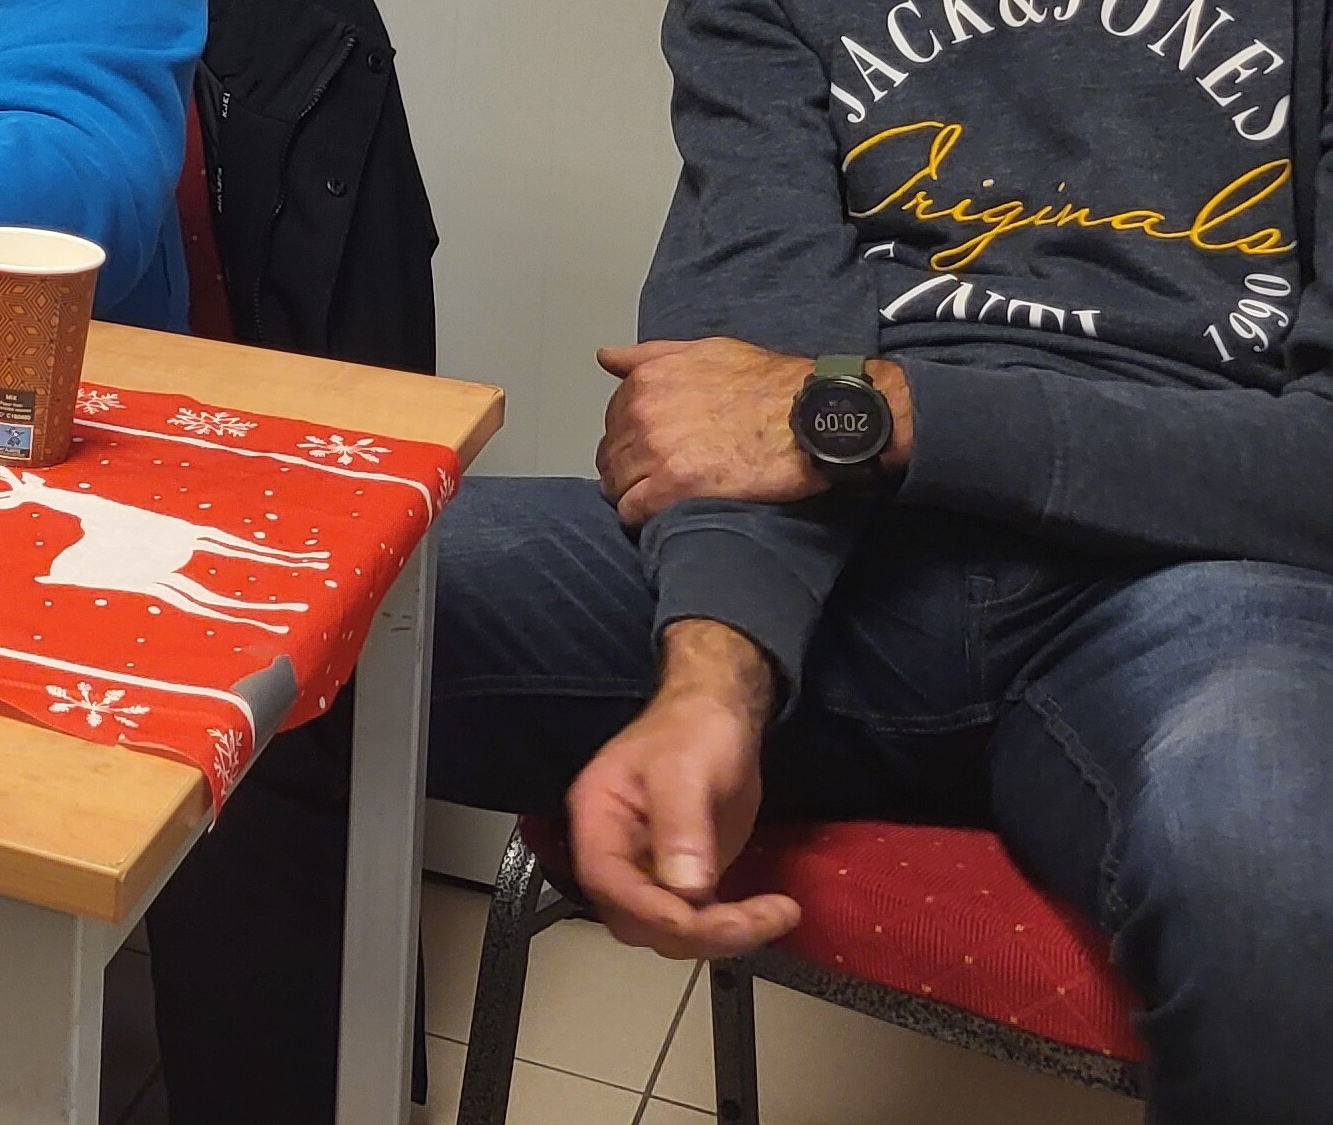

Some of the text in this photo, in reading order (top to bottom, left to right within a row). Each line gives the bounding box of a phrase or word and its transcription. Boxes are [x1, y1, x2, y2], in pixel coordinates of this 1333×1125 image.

[841, 121, 1298, 271] Originals
[1202, 273, 1291, 363] 1990
[814, 413, 869, 432] 20:09
